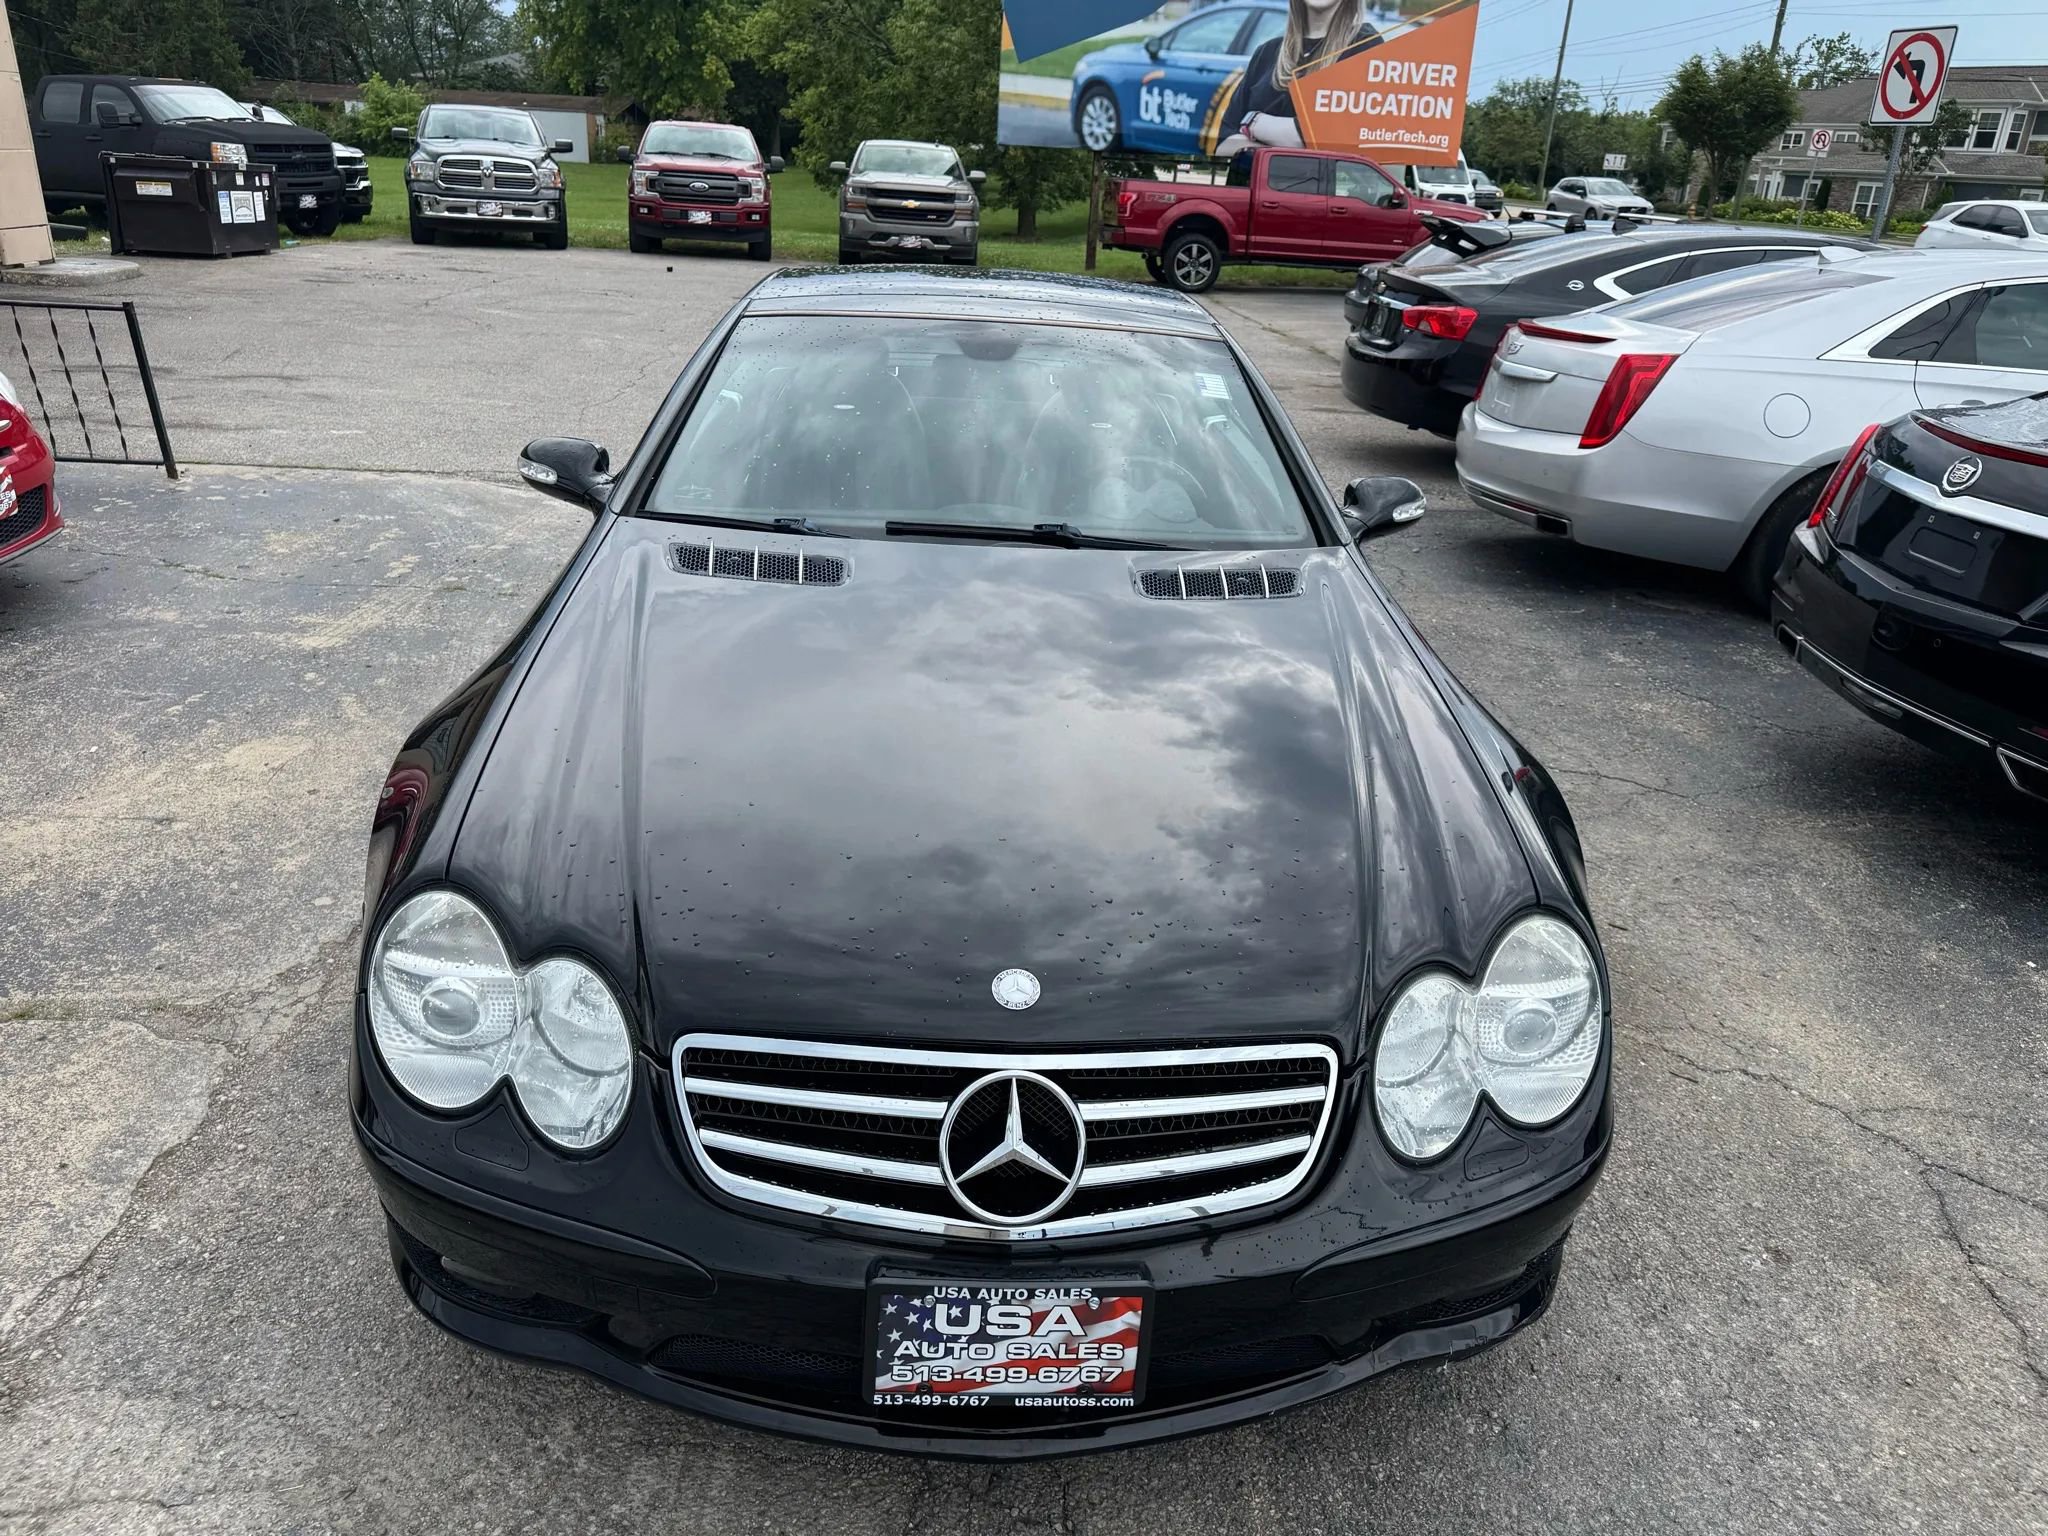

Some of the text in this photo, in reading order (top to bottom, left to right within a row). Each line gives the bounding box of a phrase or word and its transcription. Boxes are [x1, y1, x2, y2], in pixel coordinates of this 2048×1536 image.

[1367, 59, 1458, 88] DRIVER
[1314, 89, 1453, 119] EDUCATION
[1358, 127, 1449, 147] ButlerTech.org
[933, 1286, 1092, 1300] USA AUTO SALES
[934, 1303, 1087, 1337] USA
[893, 1340, 1125, 1360] AUTO SALES
[891, 1364, 1123, 1383] 513-499-6767
[873, 1394, 1134, 1407] 513-499-6767 usaautoss.com
